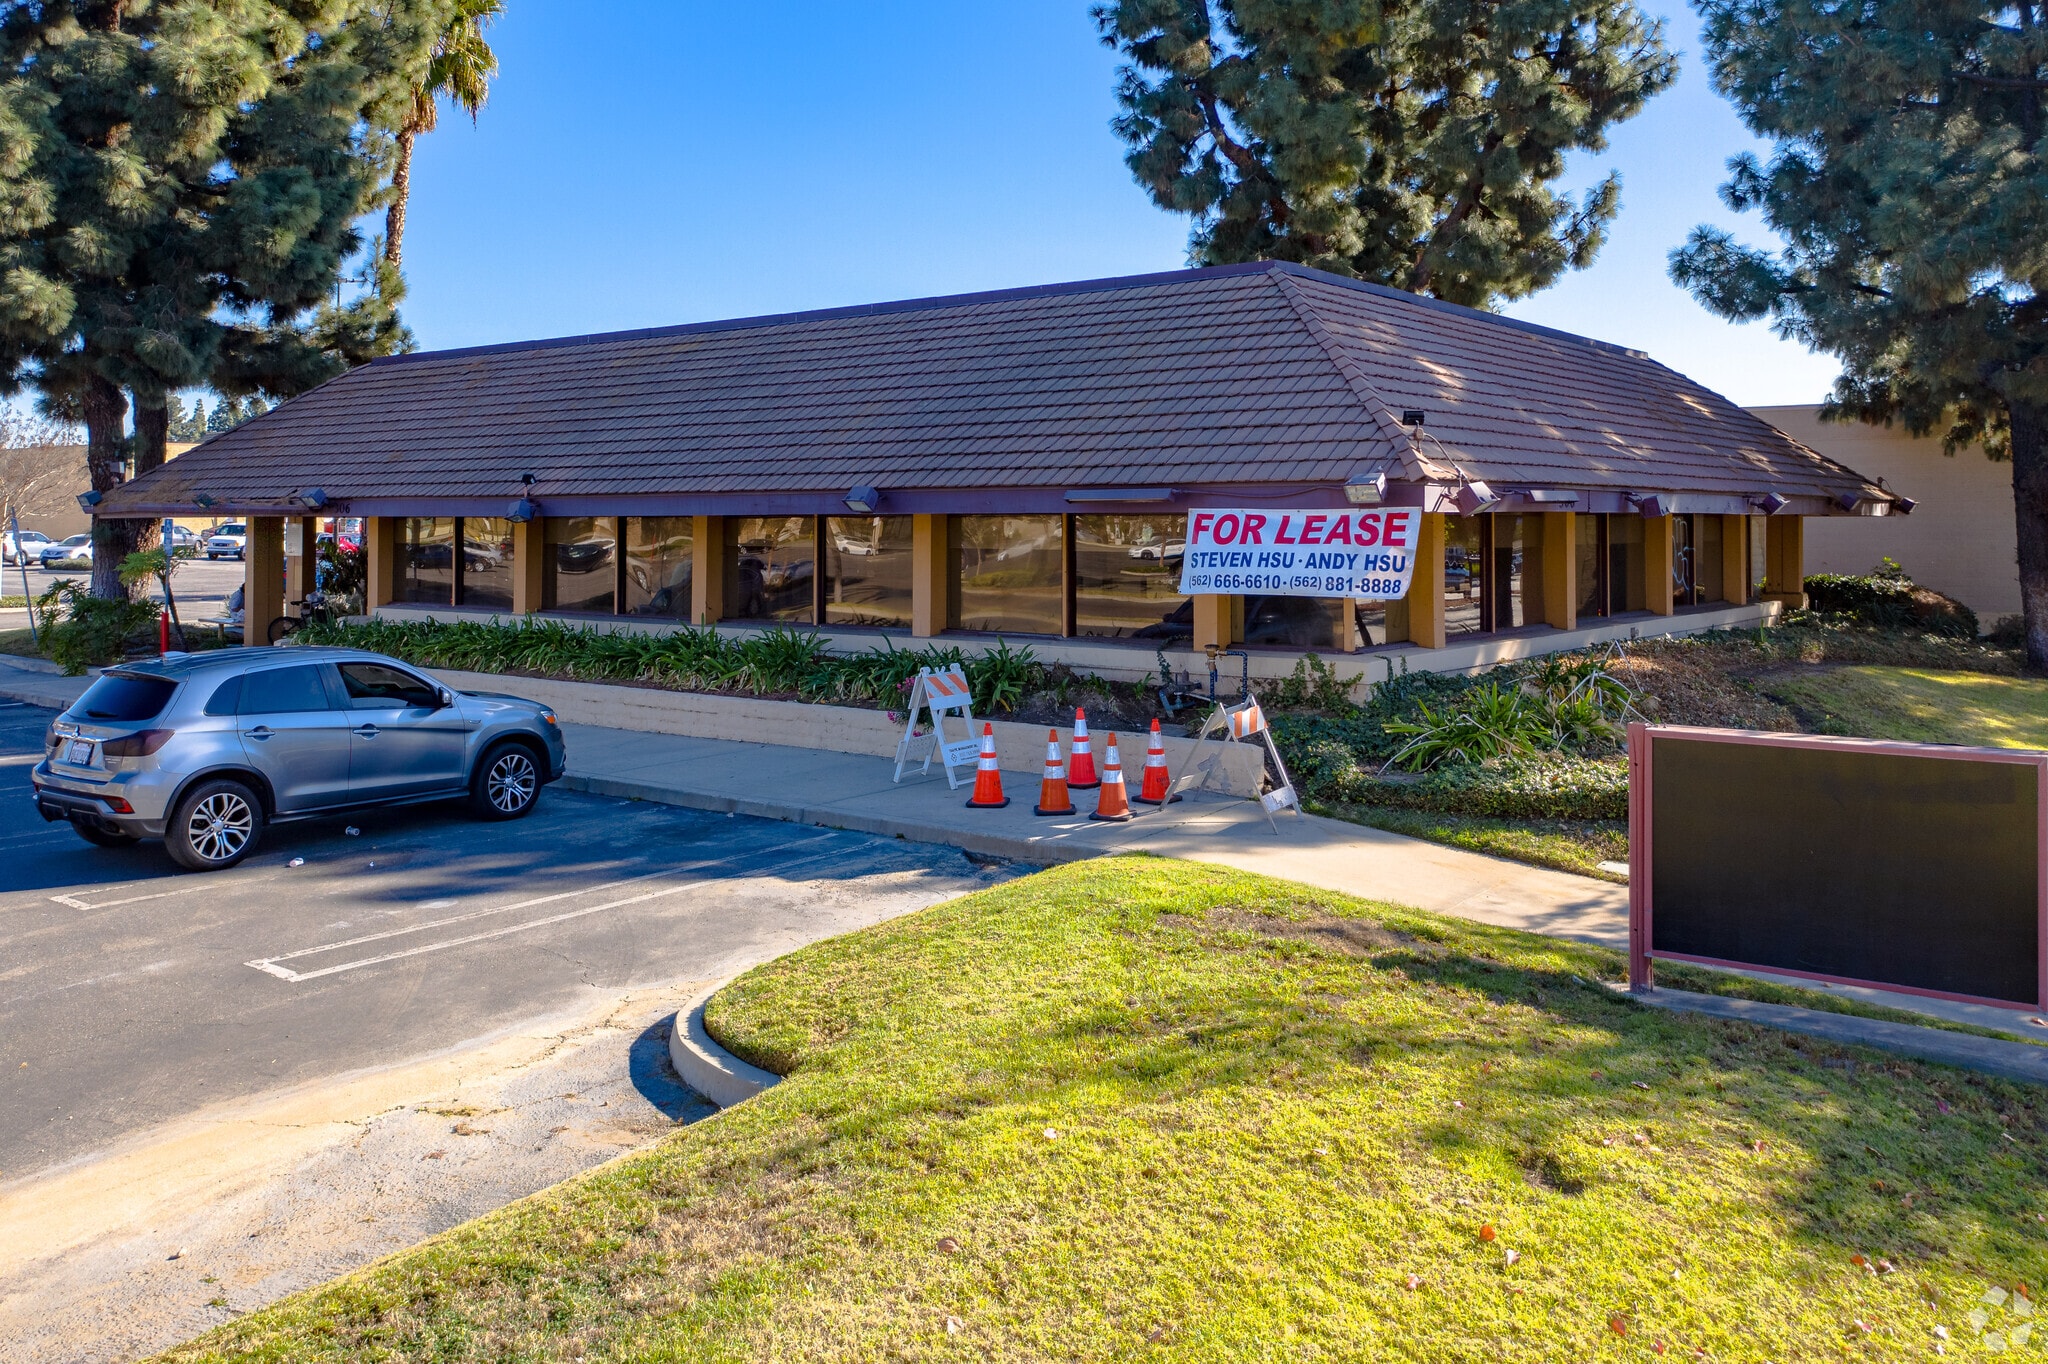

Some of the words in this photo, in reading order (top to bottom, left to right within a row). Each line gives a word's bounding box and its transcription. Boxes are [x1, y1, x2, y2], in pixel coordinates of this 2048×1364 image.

[1191, 513, 1267, 545] FOR
[1273, 512, 1410, 547] LEASE
[1190, 551, 1254, 569] STEVEN
[1257, 551, 1295, 569] HSU
[1304, 552, 1359, 570] ANDY
[1363, 554, 1406, 573] HSU
[1188, 574, 1212, 589] (562)
[1214, 574, 1281, 589] 666-6610
[1289, 575, 1322, 591] (562)
[1325, 576, 1402, 594] 881-8888
